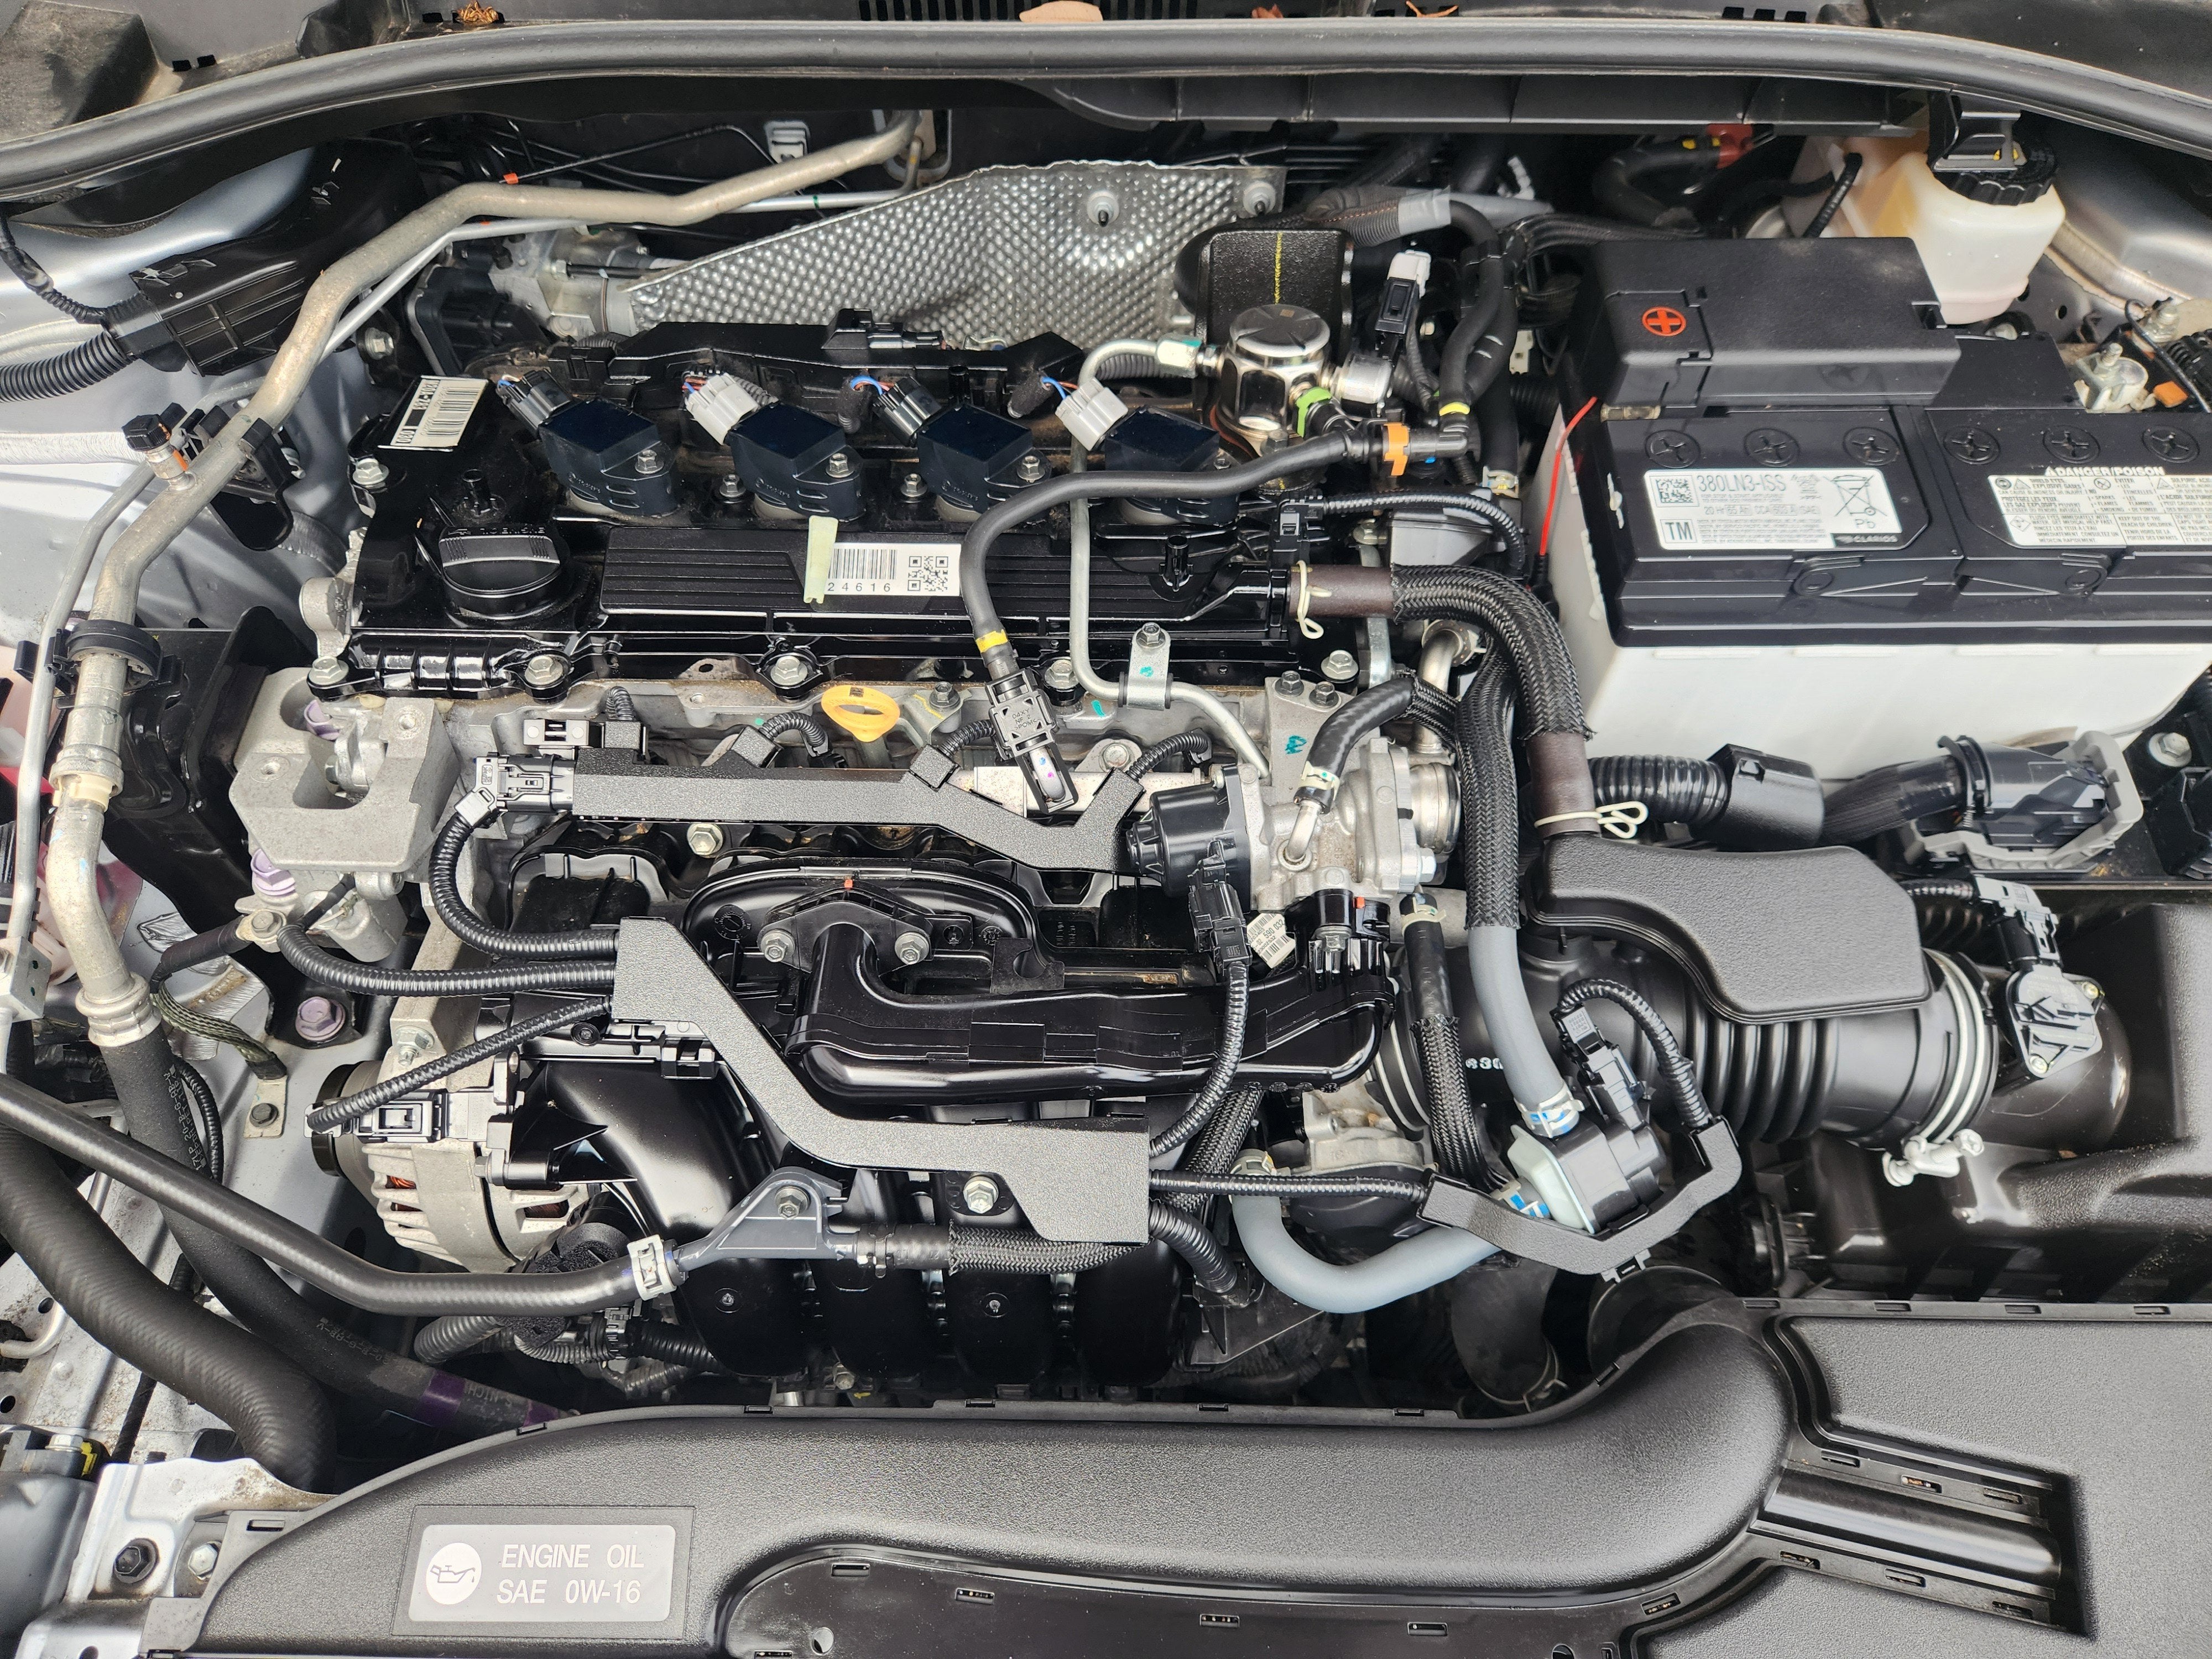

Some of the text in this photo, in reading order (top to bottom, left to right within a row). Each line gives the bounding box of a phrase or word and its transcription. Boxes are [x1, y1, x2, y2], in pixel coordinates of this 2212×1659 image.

[2055, 466, 2166, 477] DANGER/POISON
[1697, 473, 1786, 493] 380LN3-ISS
[1665, 521, 1693, 540] TM
[827, 582, 890, 592] 24616
[1262, 927, 1275, 939] 590
[1272, 919, 1285, 931] 032
[502, 1544, 644, 1568] ENGINE OIL
[497, 1579, 641, 1604] SAE 0W-16
